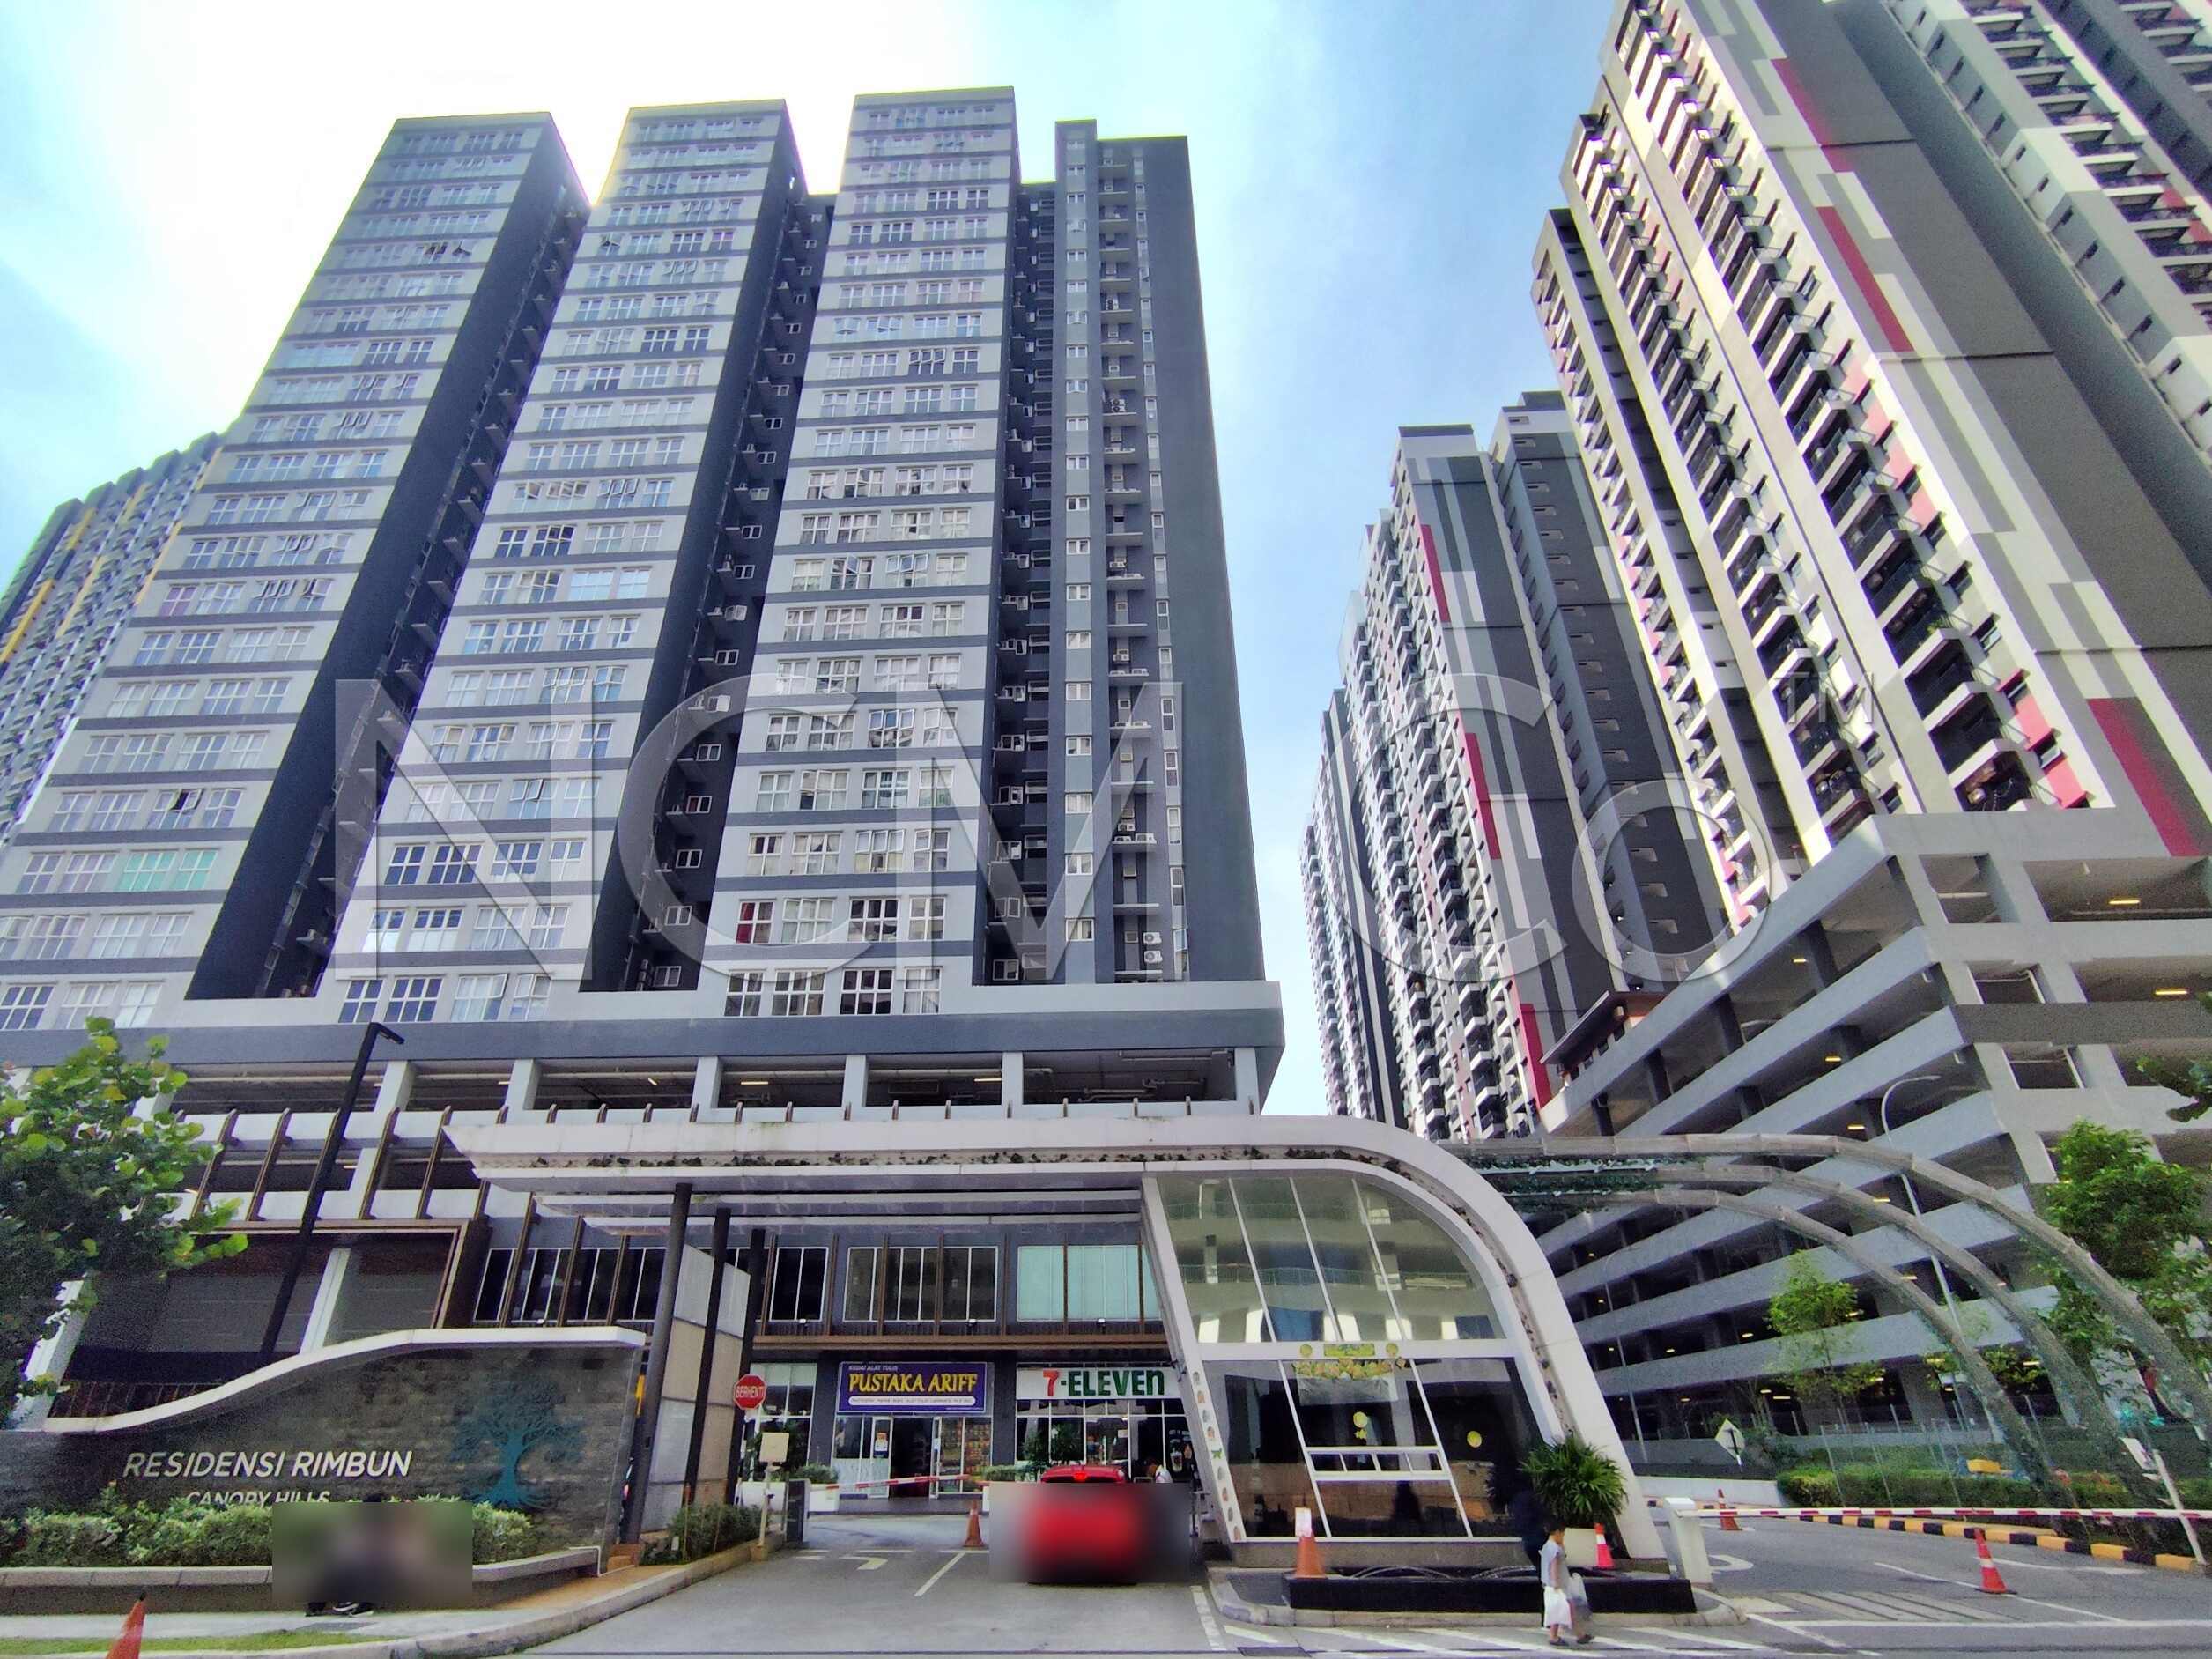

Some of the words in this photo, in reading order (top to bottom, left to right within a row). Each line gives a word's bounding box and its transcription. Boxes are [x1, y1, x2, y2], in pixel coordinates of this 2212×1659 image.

[849, 1373, 925, 1392] PUSTAKA
[928, 1373, 978, 1392] ARIFF
[122, 1451, 286, 1478] RESIDENSI
[292, 1450, 413, 1478] RIMBUN
